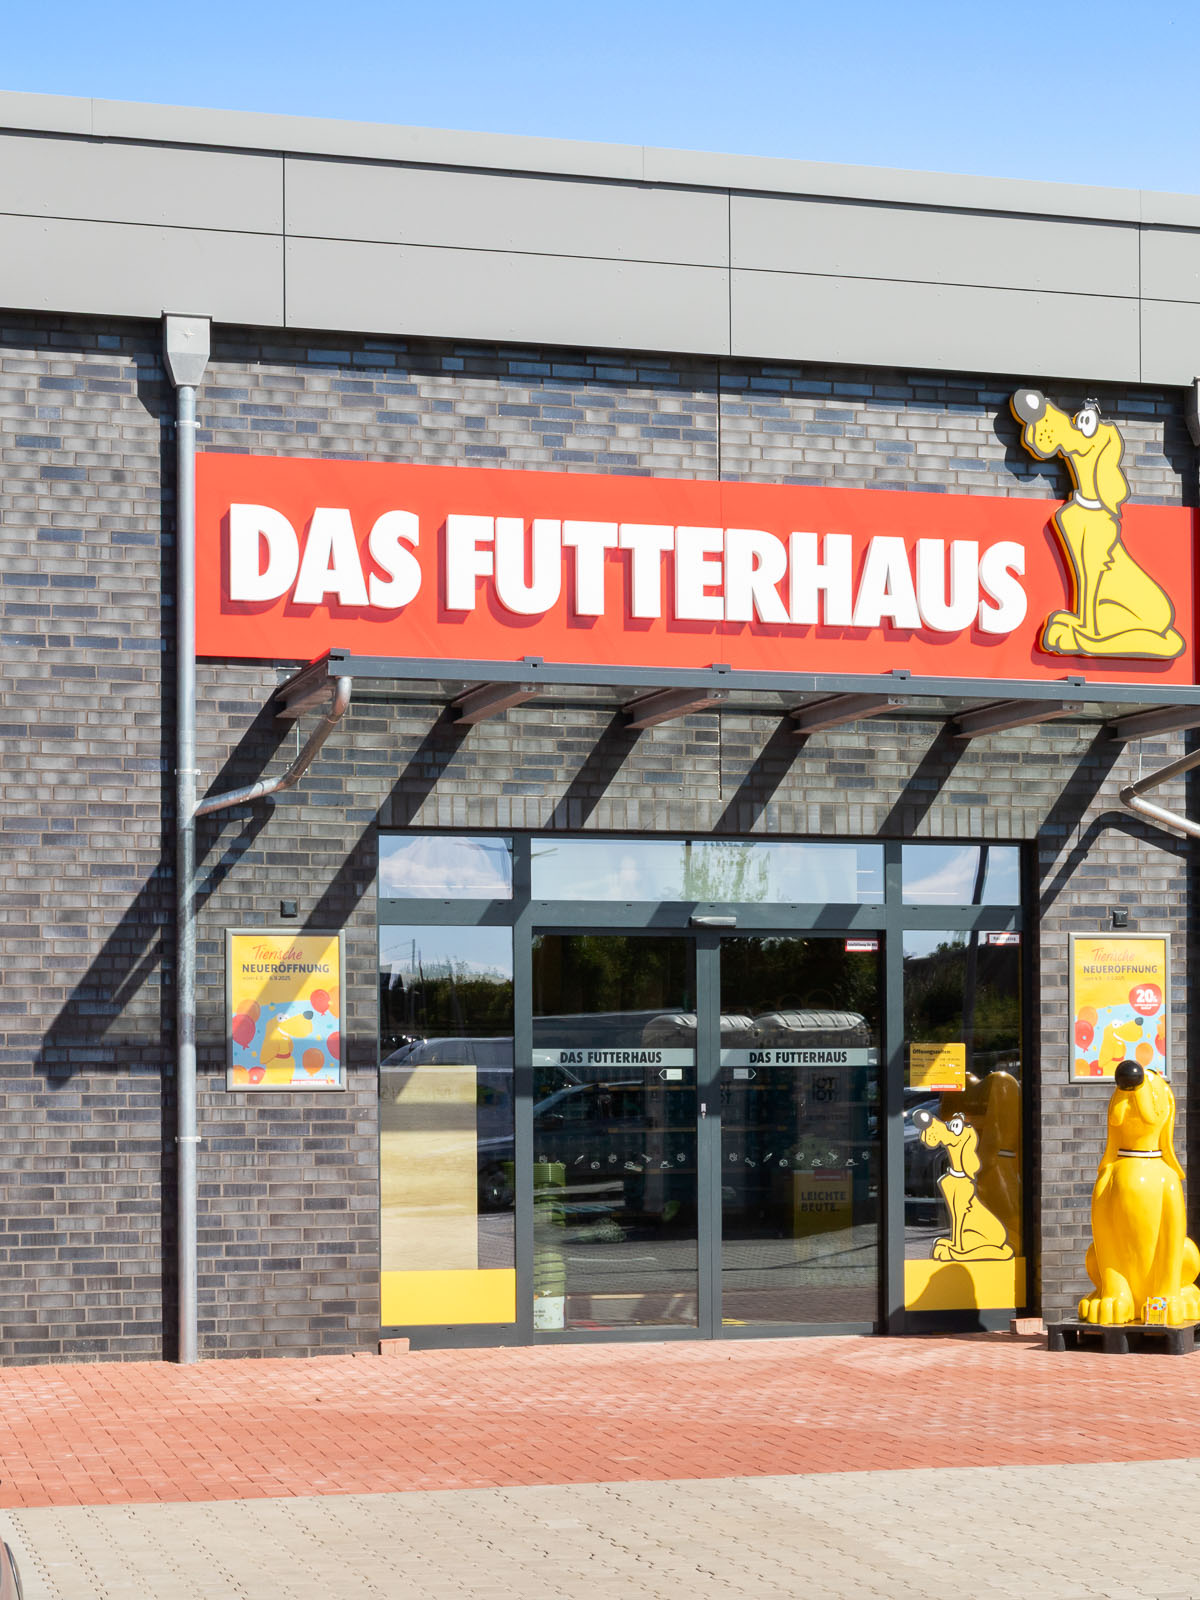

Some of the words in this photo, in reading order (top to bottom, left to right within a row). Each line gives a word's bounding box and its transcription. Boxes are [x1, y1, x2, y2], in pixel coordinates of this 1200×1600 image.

[228, 503, 420, 610] DAS
[446, 515, 1027, 634] FUTTERHAUS
[252, 944, 304, 961] Tierische
[1091, 947, 1136, 962] Tierische
[242, 961, 330, 974] NEUERÖFFNUNG
[1083, 962, 1158, 974] NEUERÖFFNUNG
[559, 1051, 584, 1064] DAS
[587, 1051, 662, 1064] FUTTERHAUS
[749, 1051, 772, 1064] DAS
[775, 1051, 848, 1063] FUTTERHAUS
[801, 1191, 847, 1201] LEICHTE
